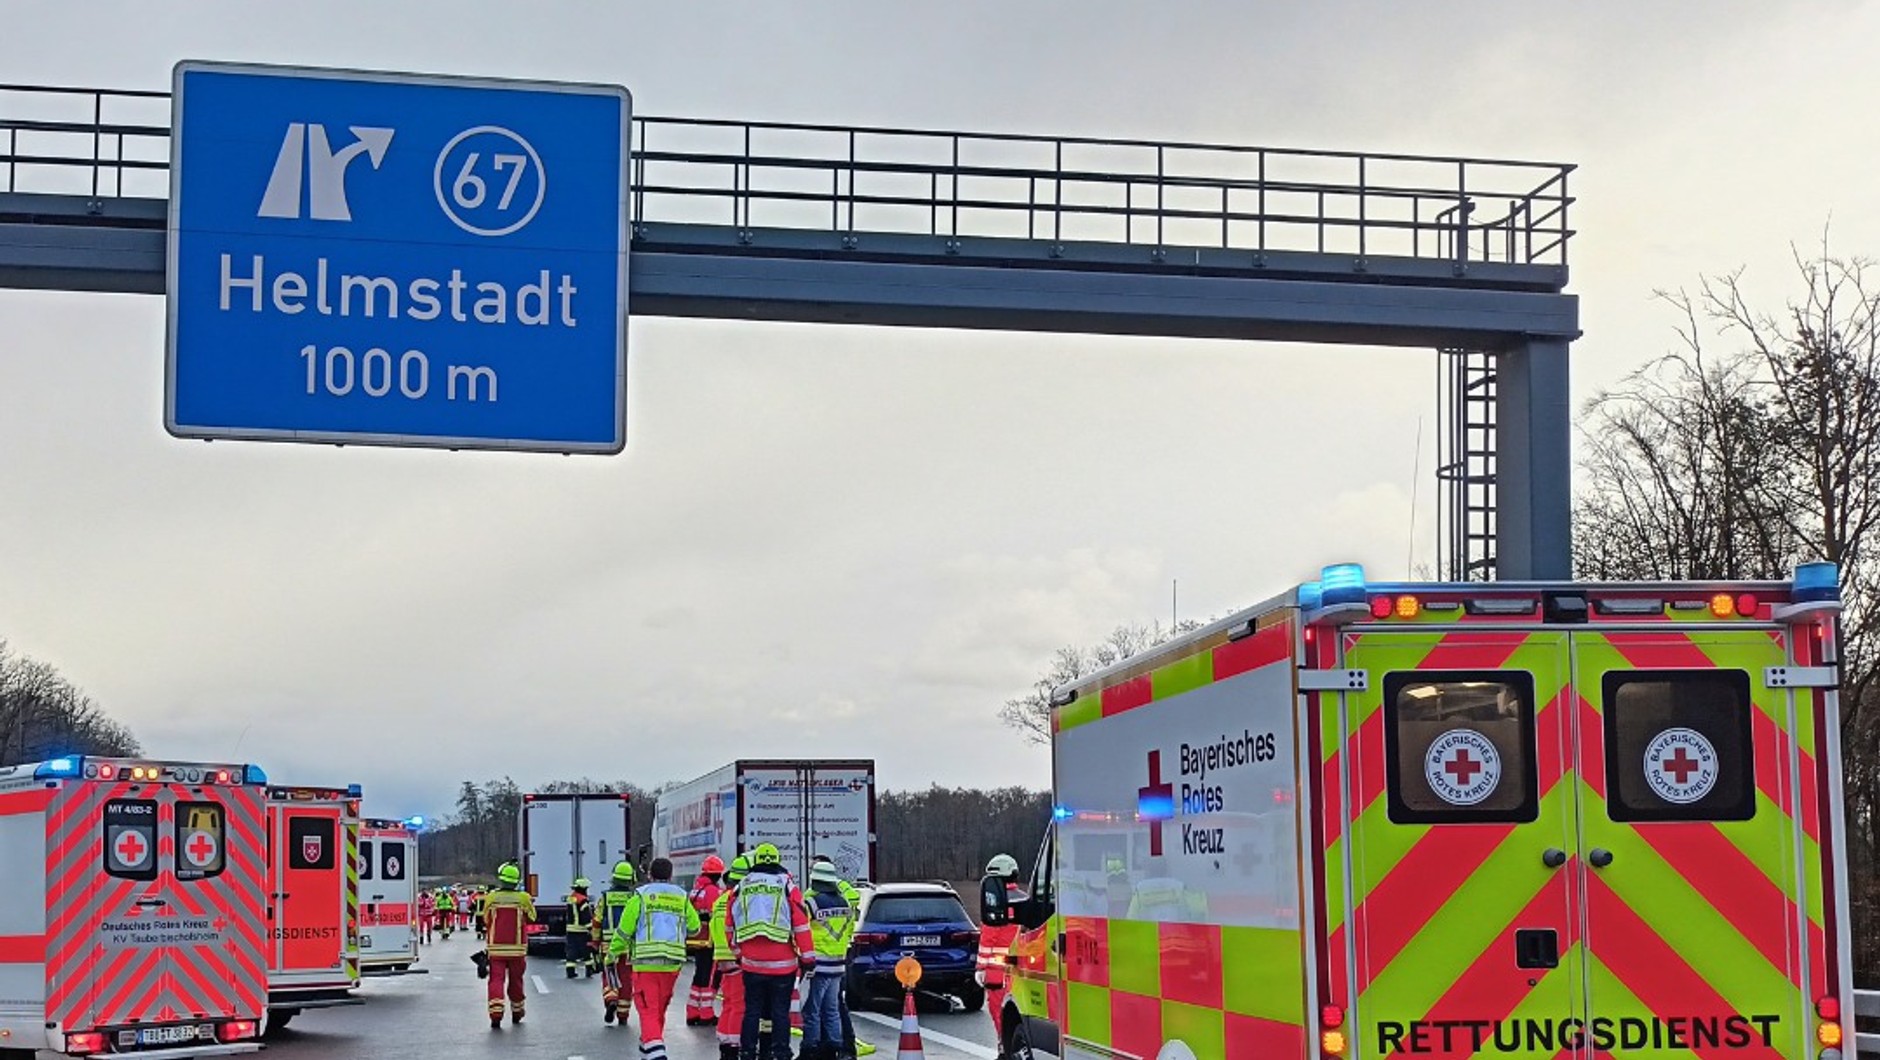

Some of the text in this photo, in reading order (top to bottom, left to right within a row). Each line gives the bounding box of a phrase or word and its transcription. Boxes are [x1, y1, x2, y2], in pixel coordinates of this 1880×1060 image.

[452, 152, 527, 211] 67
[219, 253, 577, 328] Helmstadt
[300, 345, 498, 402] 1000 m
[1180, 729, 1276, 781] Bayerisches
[1432, 735, 1493, 763] BAYERISCHES
[1650, 734, 1711, 762] BAYERISCHES
[1432, 771, 1493, 799] ROTES KREUZ
[1651, 769, 1712, 796] ROTES KREUZ
[108, 805, 122, 814] MT
[1181, 783, 1224, 815] Rotes
[1182, 822, 1225, 856] Kreuz
[101, 922, 151, 931] Deutsches
[182, 920, 209, 929] Kreuz
[1376, 1015, 1780, 1054] RETTUNGSDIENST
